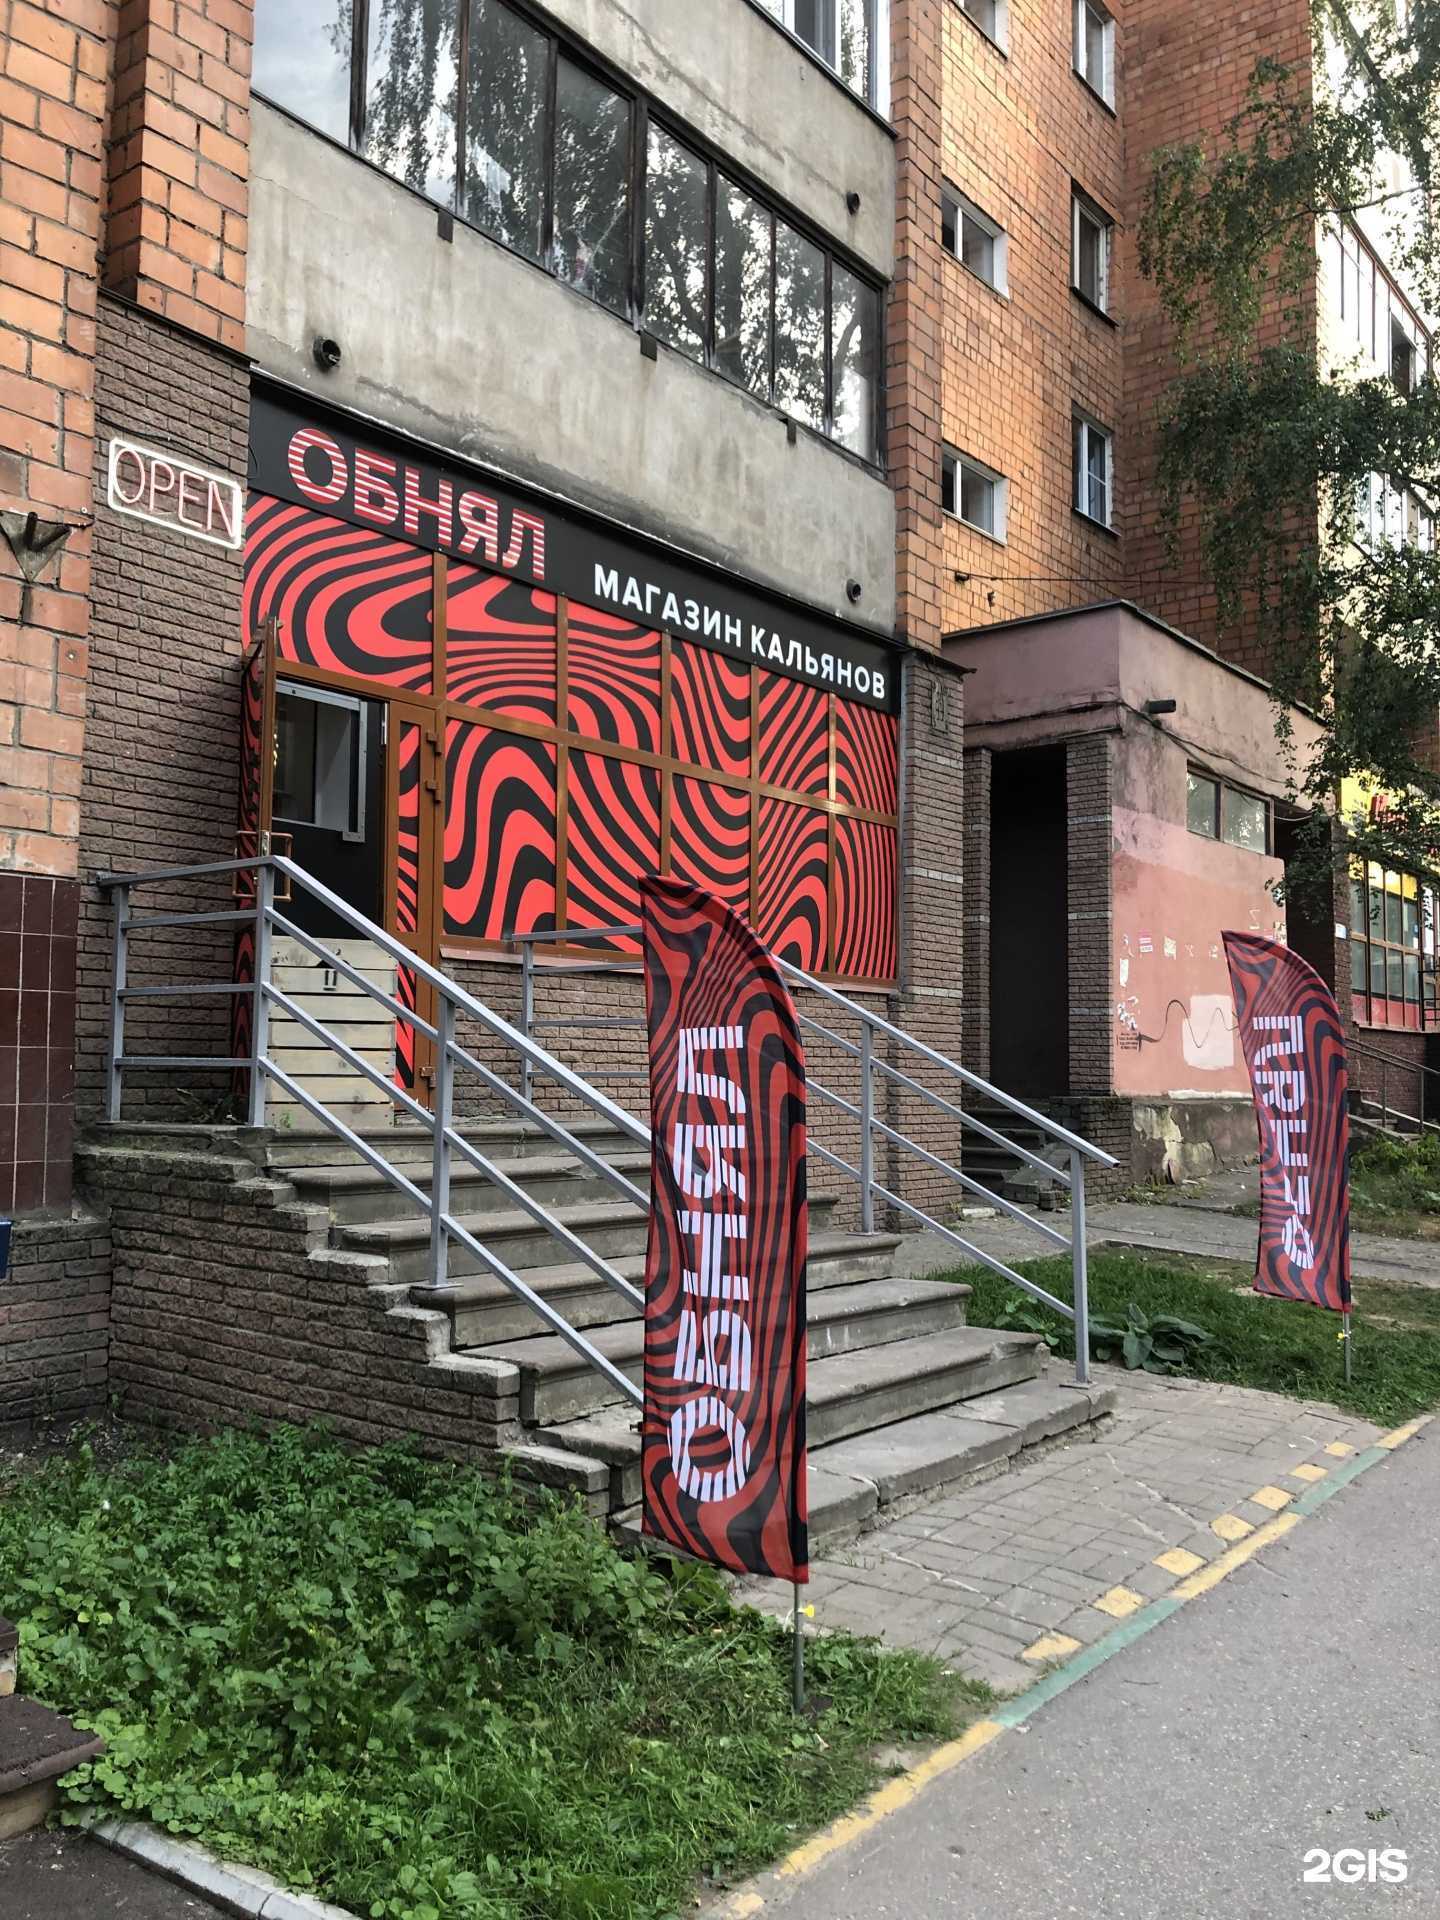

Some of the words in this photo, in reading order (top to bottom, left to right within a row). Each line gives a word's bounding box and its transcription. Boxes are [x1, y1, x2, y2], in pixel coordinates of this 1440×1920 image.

[113, 449, 236, 538] OPEN
[288, 428, 545, 580] ОБНЯЛ
[594, 563, 742, 648] МАГАЗИН
[751, 625, 885, 699] КАЛЬЯНОВ
[667, 1025, 751, 1502] ОБНЯЛ
